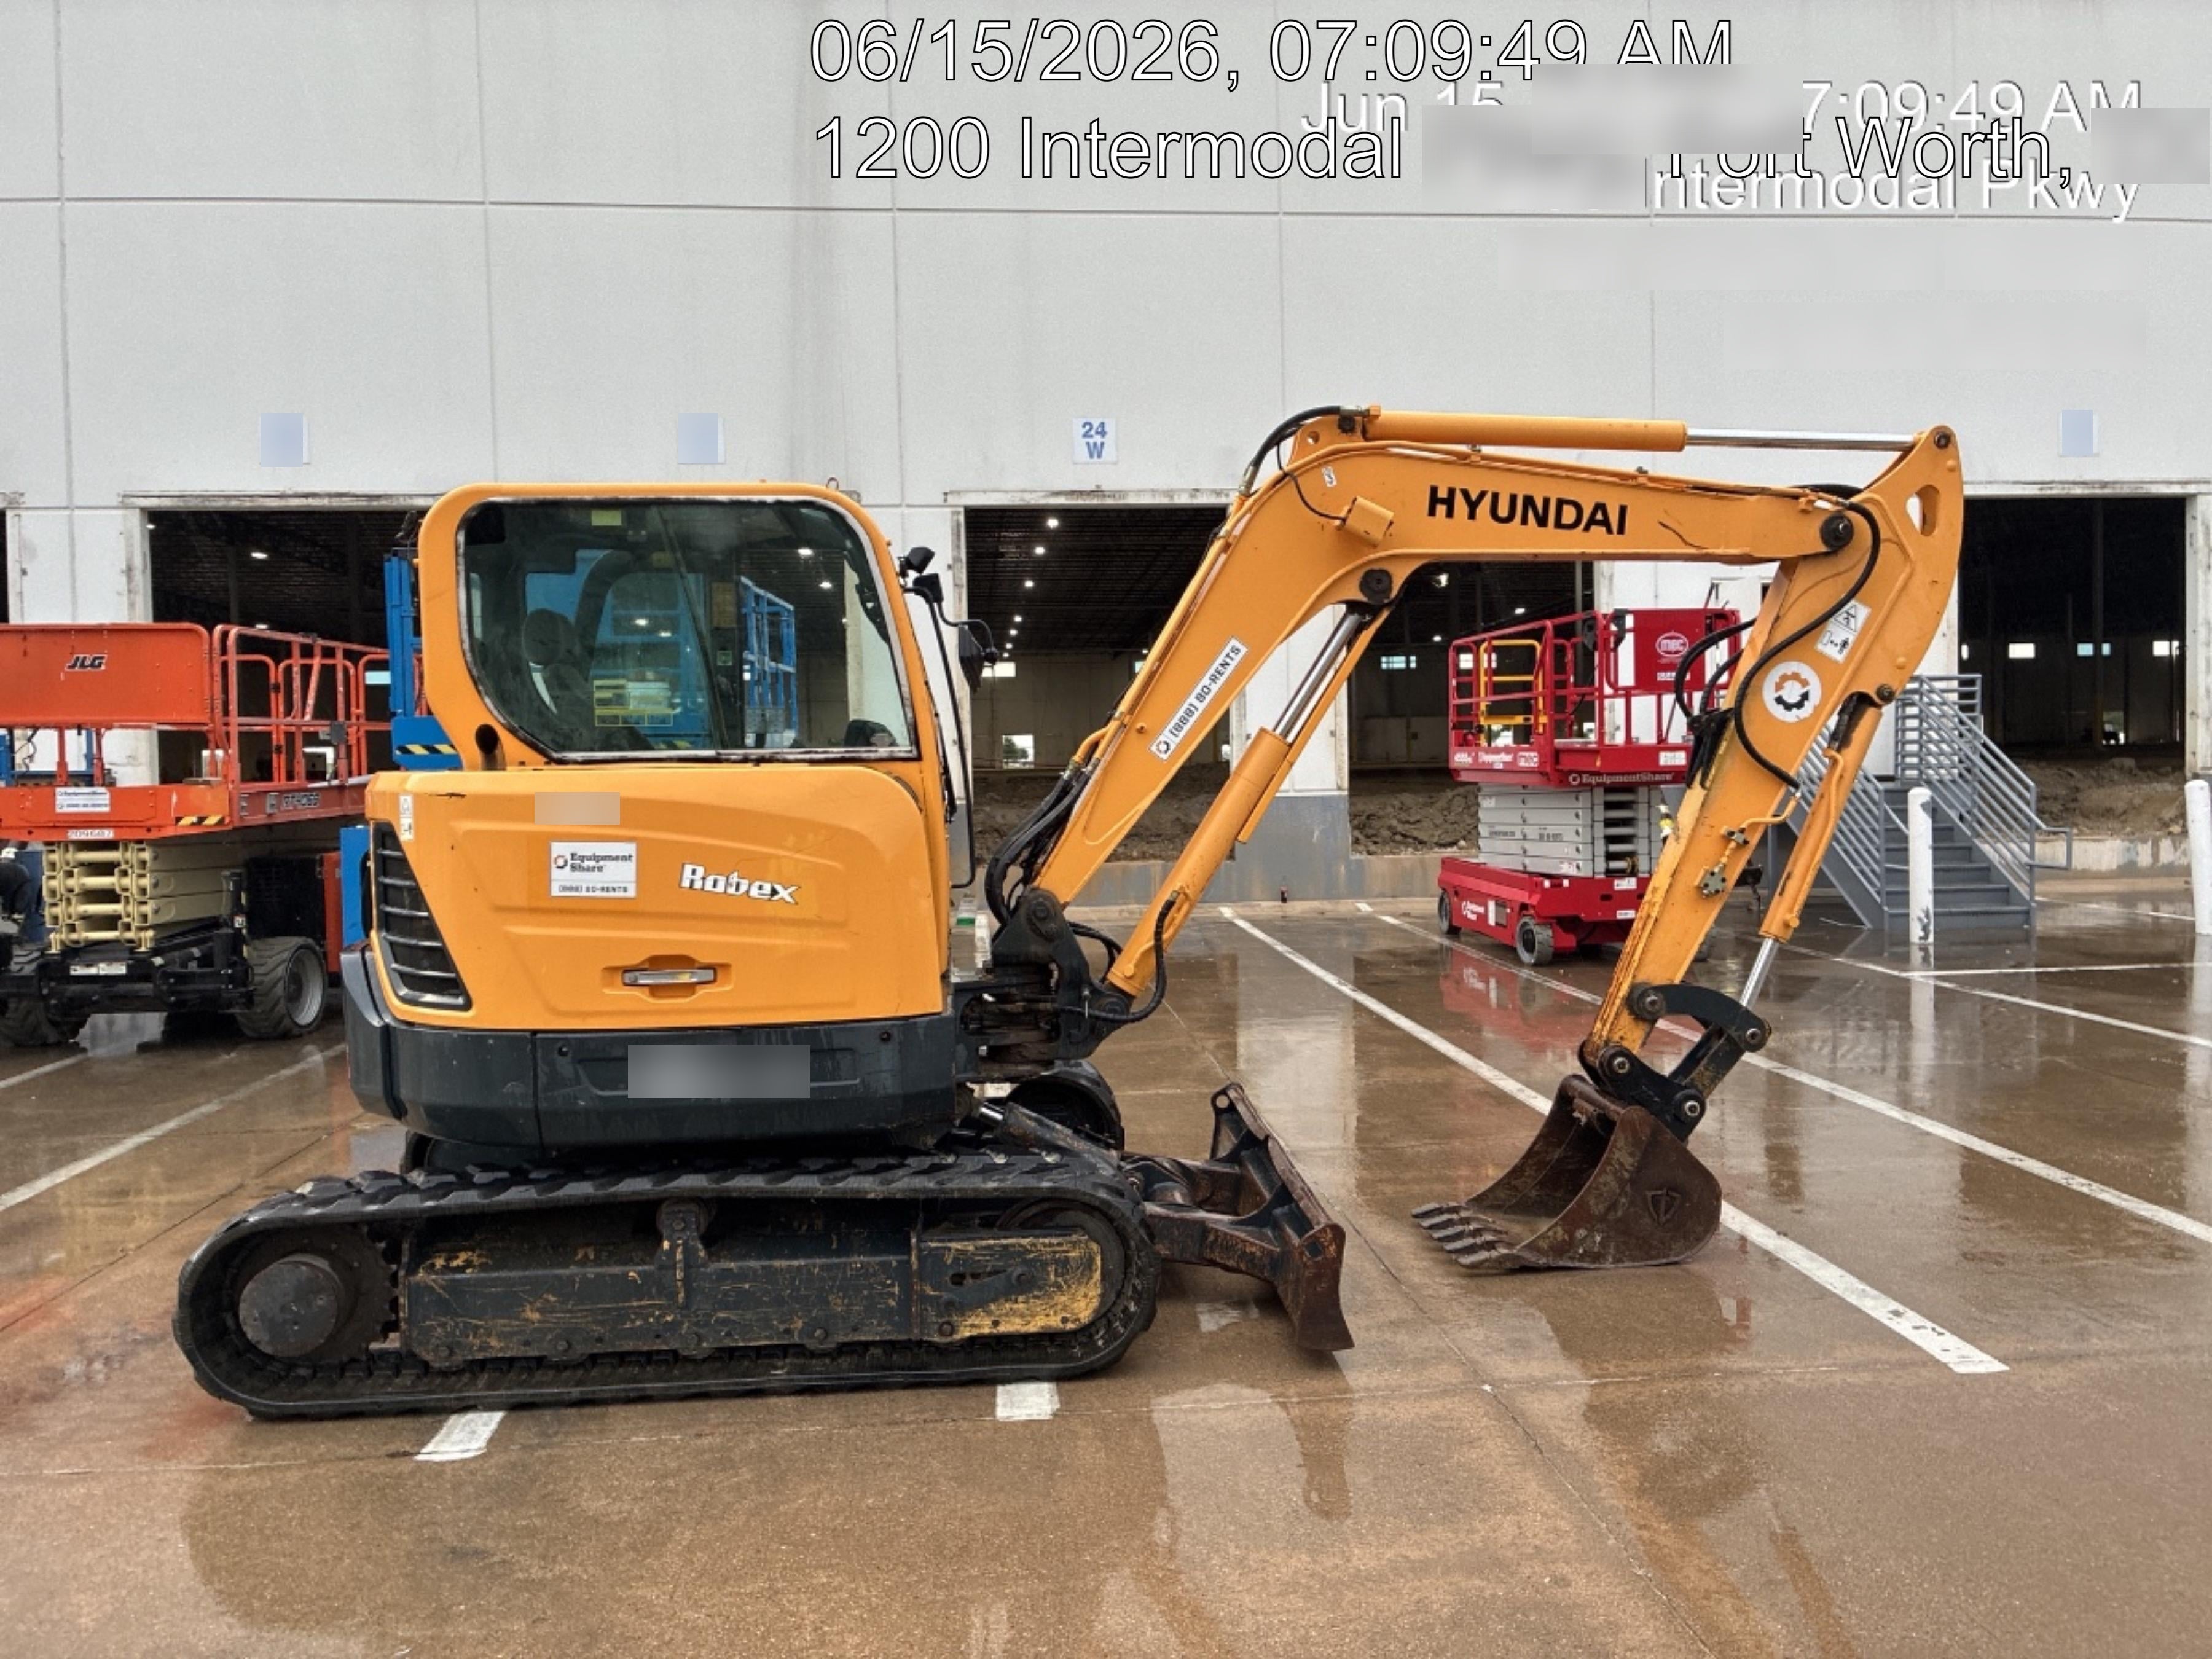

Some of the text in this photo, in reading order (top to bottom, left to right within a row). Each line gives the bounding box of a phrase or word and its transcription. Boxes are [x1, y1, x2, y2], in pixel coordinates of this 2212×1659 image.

[1081, 422, 1108, 439] 24
[1085, 441, 1105, 460] W
[1427, 485, 1628, 535] HYUNDAI
[65, 654, 107, 671] JLG
[1194, 645, 1242, 704] 80-RENTS
[570, 852, 633, 863] Equipment
[680, 862, 801, 905] Robex
